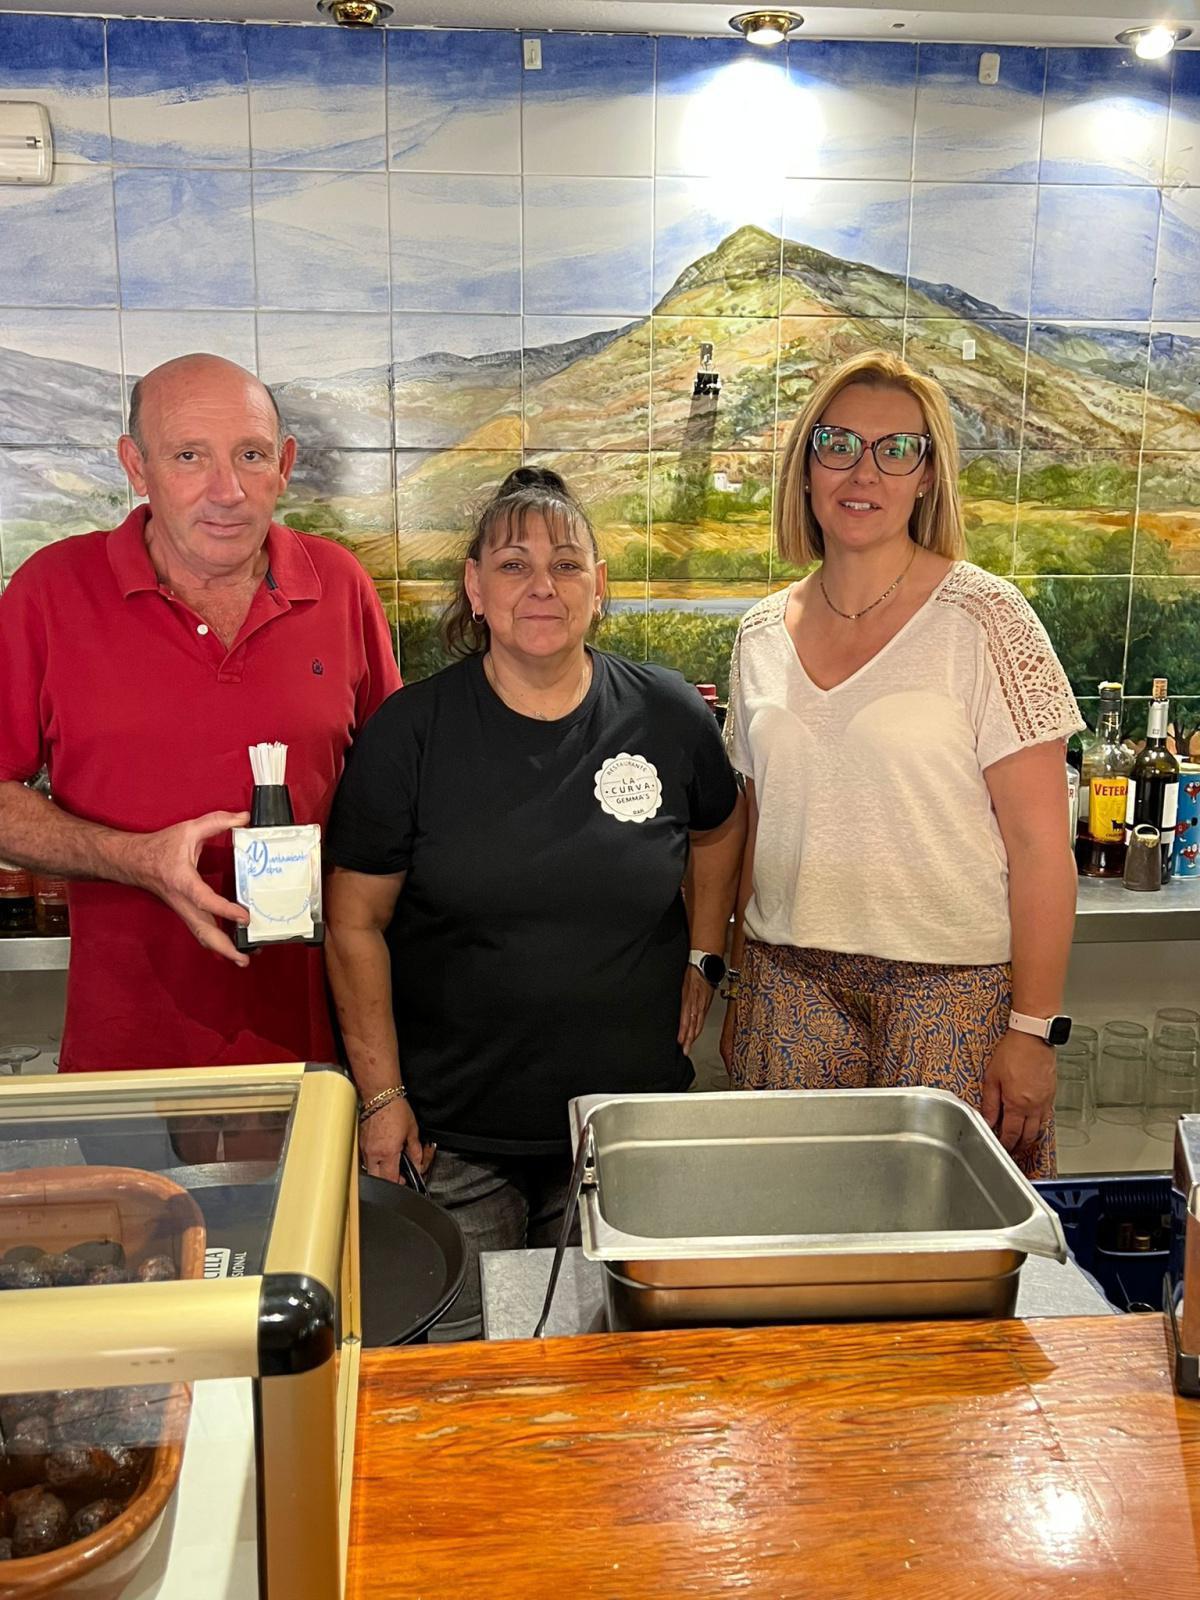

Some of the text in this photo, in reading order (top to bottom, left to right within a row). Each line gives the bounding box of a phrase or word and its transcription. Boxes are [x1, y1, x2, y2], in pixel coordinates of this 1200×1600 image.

[607, 761, 647, 775] RESTAURANTE
[622, 777, 635, 785] LA
[611, 782, 650, 794] CURVA
[616, 793, 650, 804] GEMMA'S
